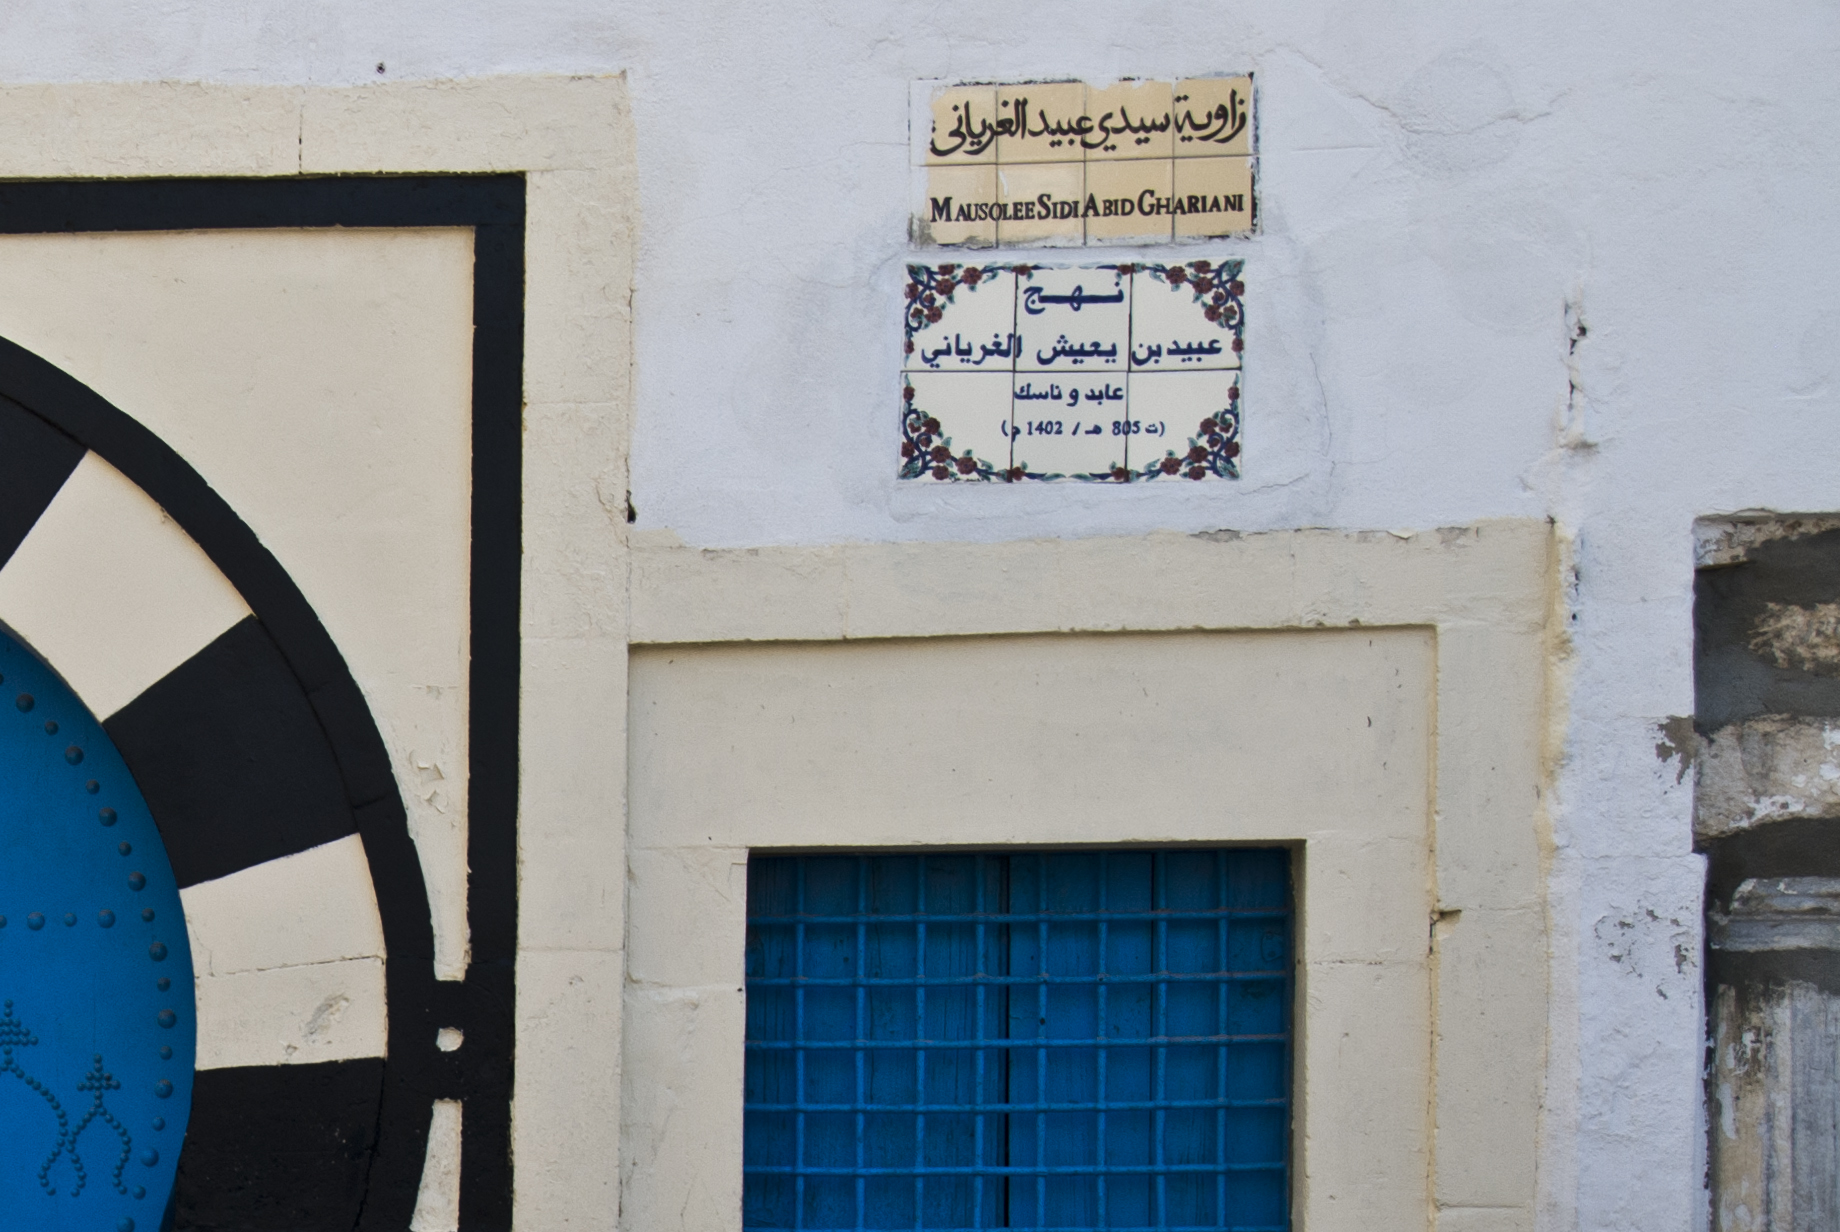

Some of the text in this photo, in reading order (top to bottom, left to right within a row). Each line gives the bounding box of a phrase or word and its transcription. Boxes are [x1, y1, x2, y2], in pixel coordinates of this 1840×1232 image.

[1027, 109, 1094, 148] عبيد
[1080, 105, 1171, 152] سيدي
[1174, 88, 1247, 144] زاوية
[1023, 279, 1125, 315] نهج
[921, 332, 1223, 369] عبيد بن يعيش الغرياني
[1014, 382, 1124, 407] عابد و ناسك
[1027, 420, 1063, 436] 1402
[1112, 420, 1141, 436] 805
